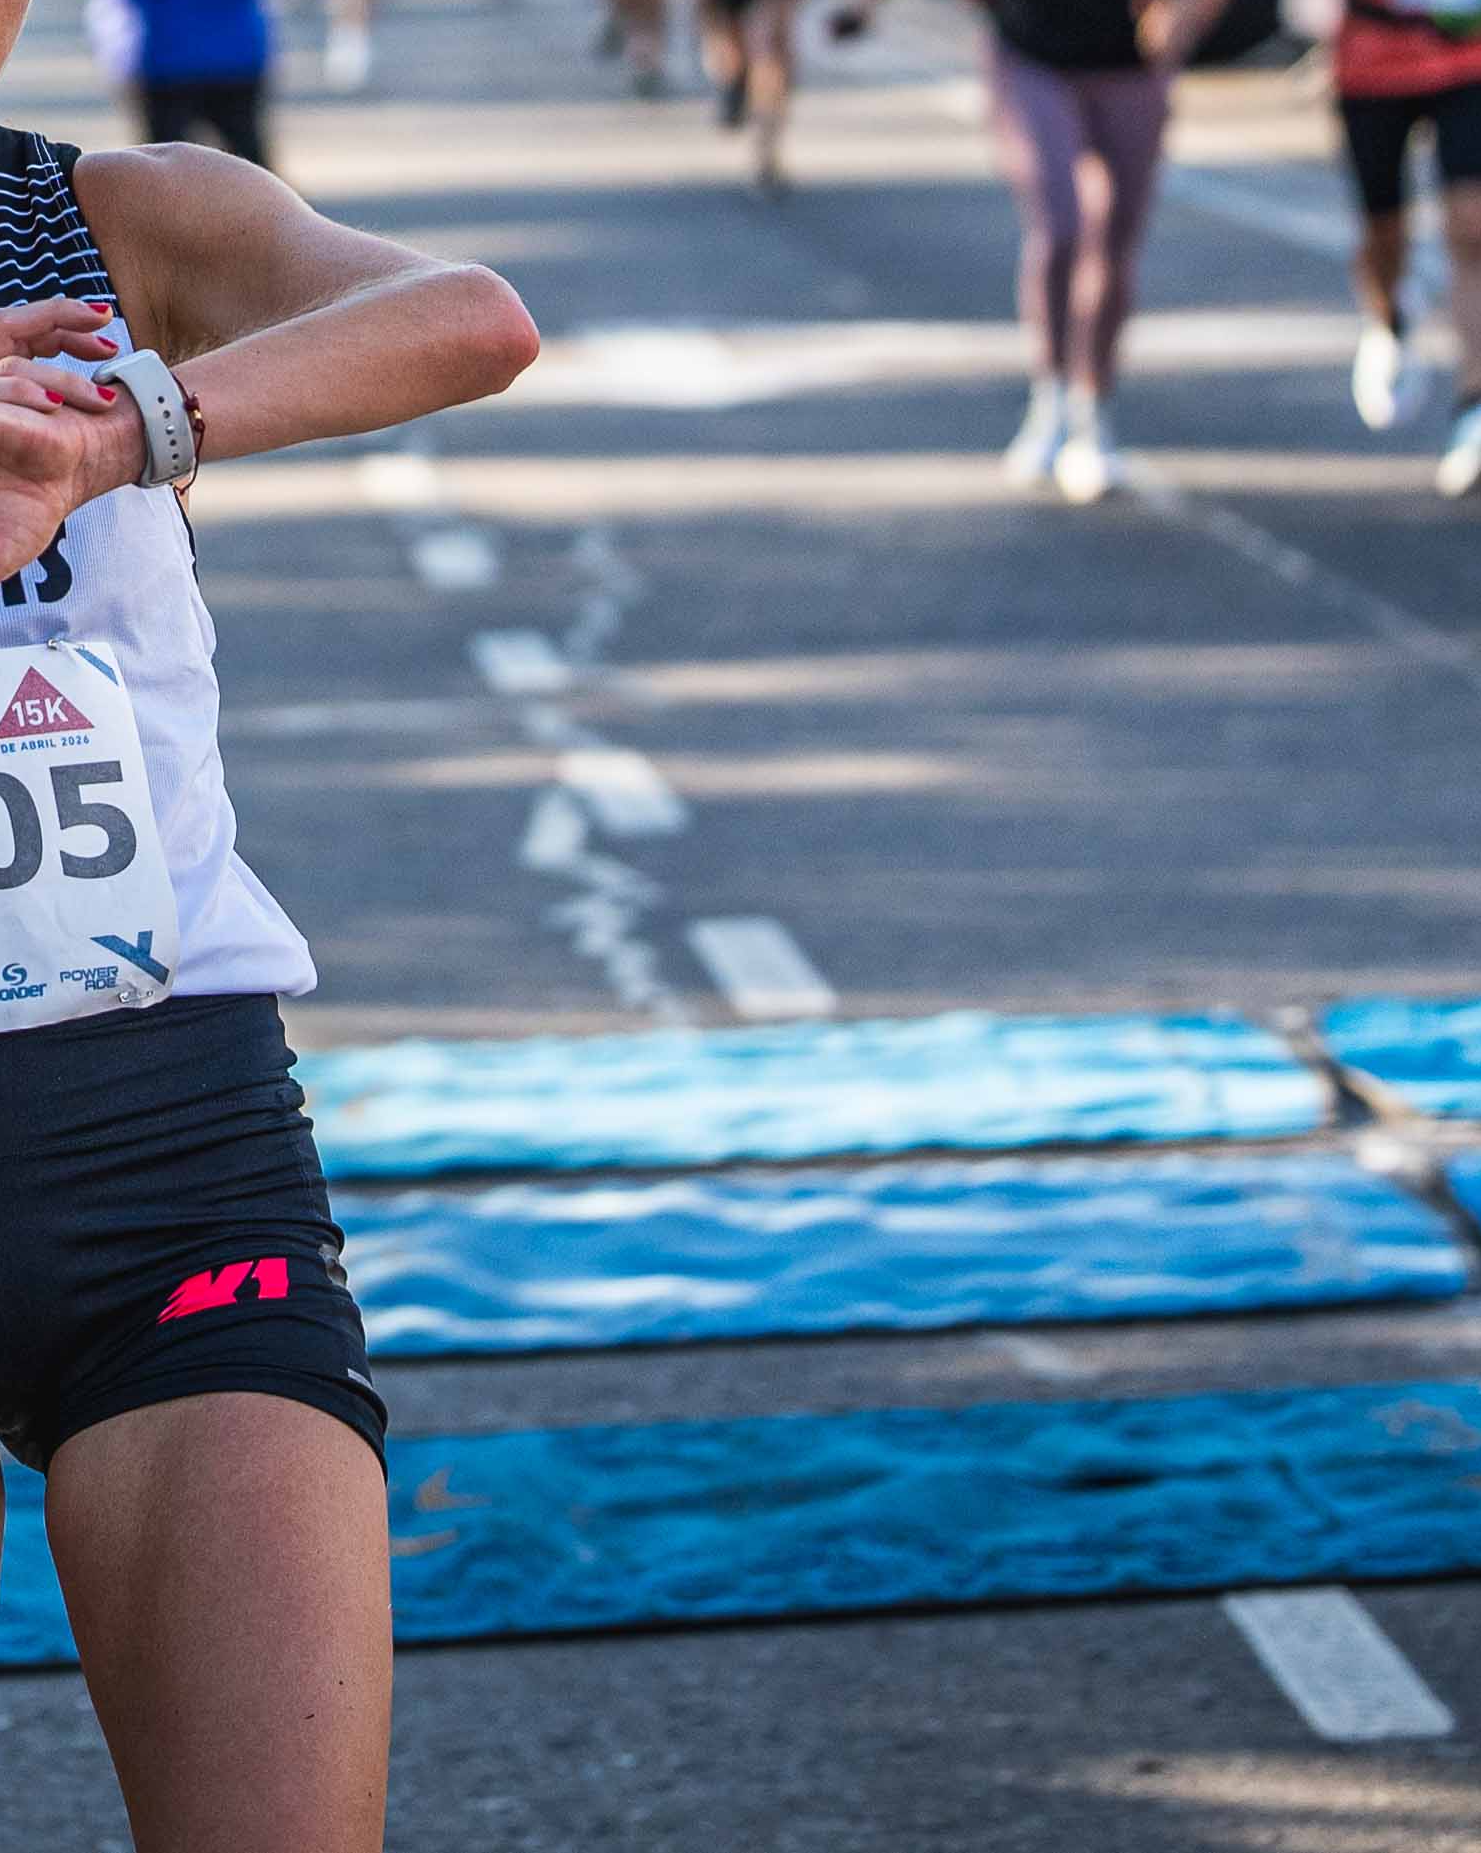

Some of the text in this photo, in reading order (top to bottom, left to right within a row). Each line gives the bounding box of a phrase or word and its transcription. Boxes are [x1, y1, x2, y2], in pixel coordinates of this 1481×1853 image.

[11, 695, 69, 728] 15K
[0, 743, 16, 754] DE
[20, 738, 56, 752] ABRIL
[61, 735, 90, 747] 2026
[59, 965, 119, 983] POWER
[84, 978, 118, 991] ADE
